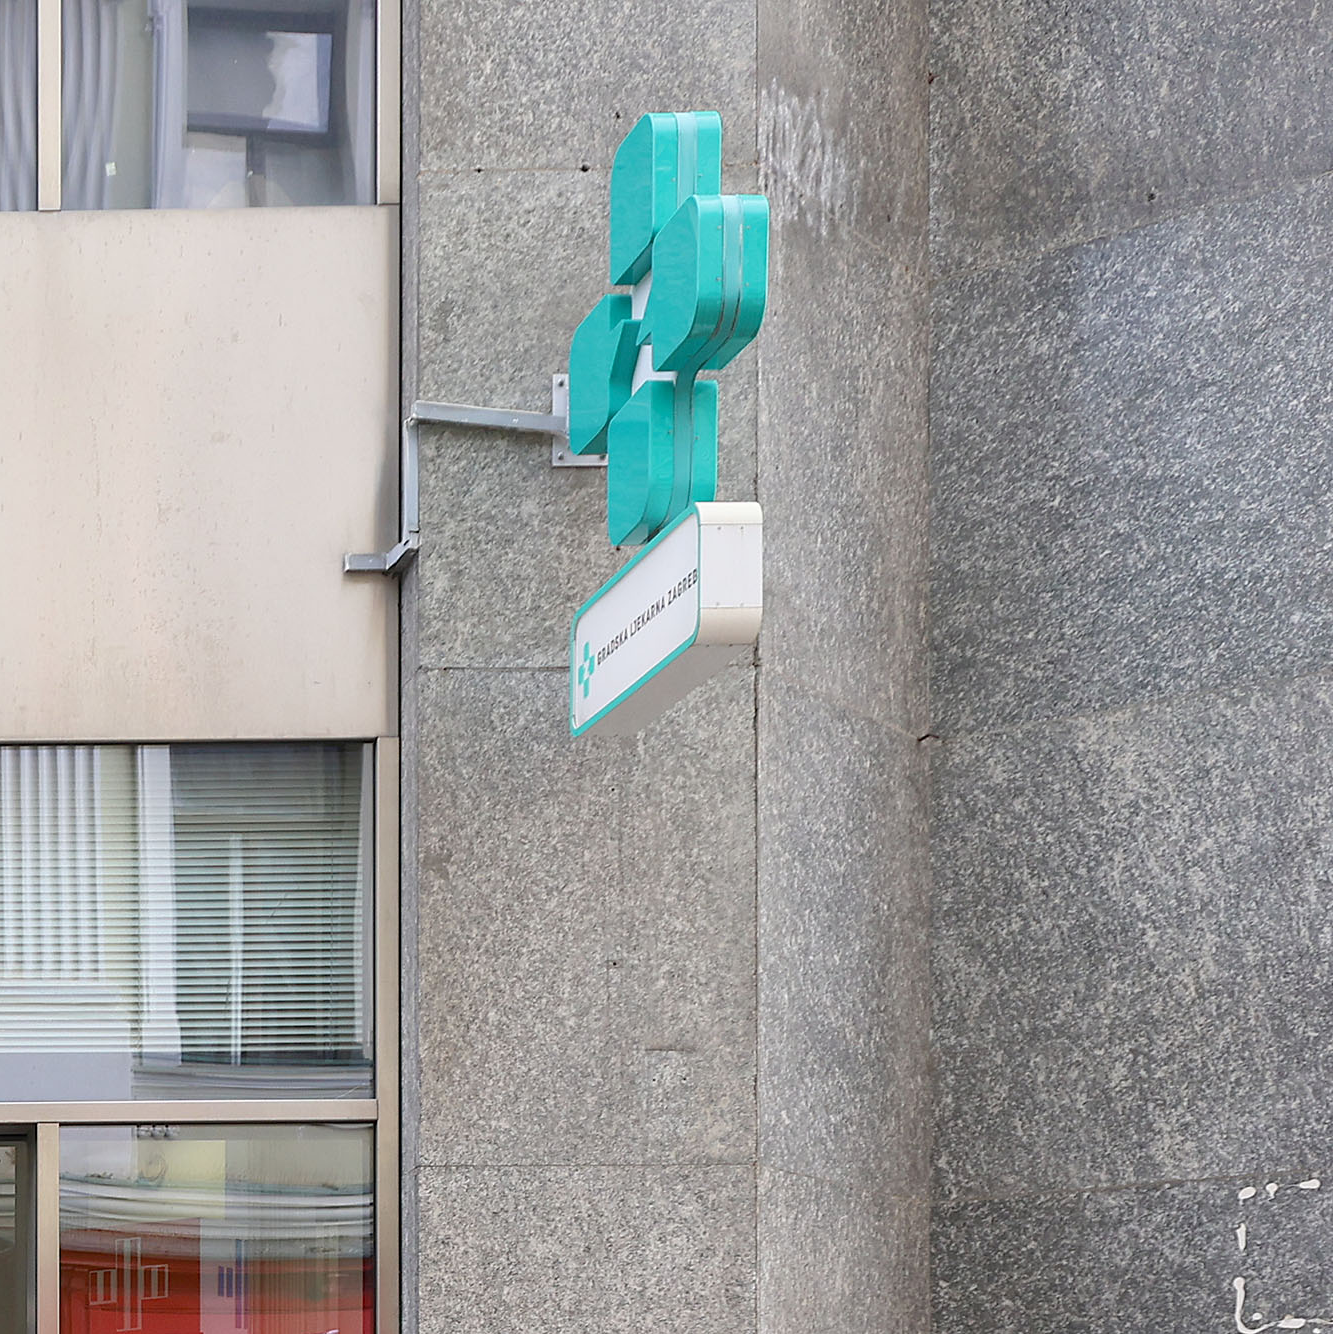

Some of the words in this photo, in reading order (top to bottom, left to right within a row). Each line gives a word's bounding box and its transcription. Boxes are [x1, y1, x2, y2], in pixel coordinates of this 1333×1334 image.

[597, 628, 629, 665] GRADSKA
[630, 596, 666, 640] LJEKARNA
[668, 568, 699, 605] ZAGREB
